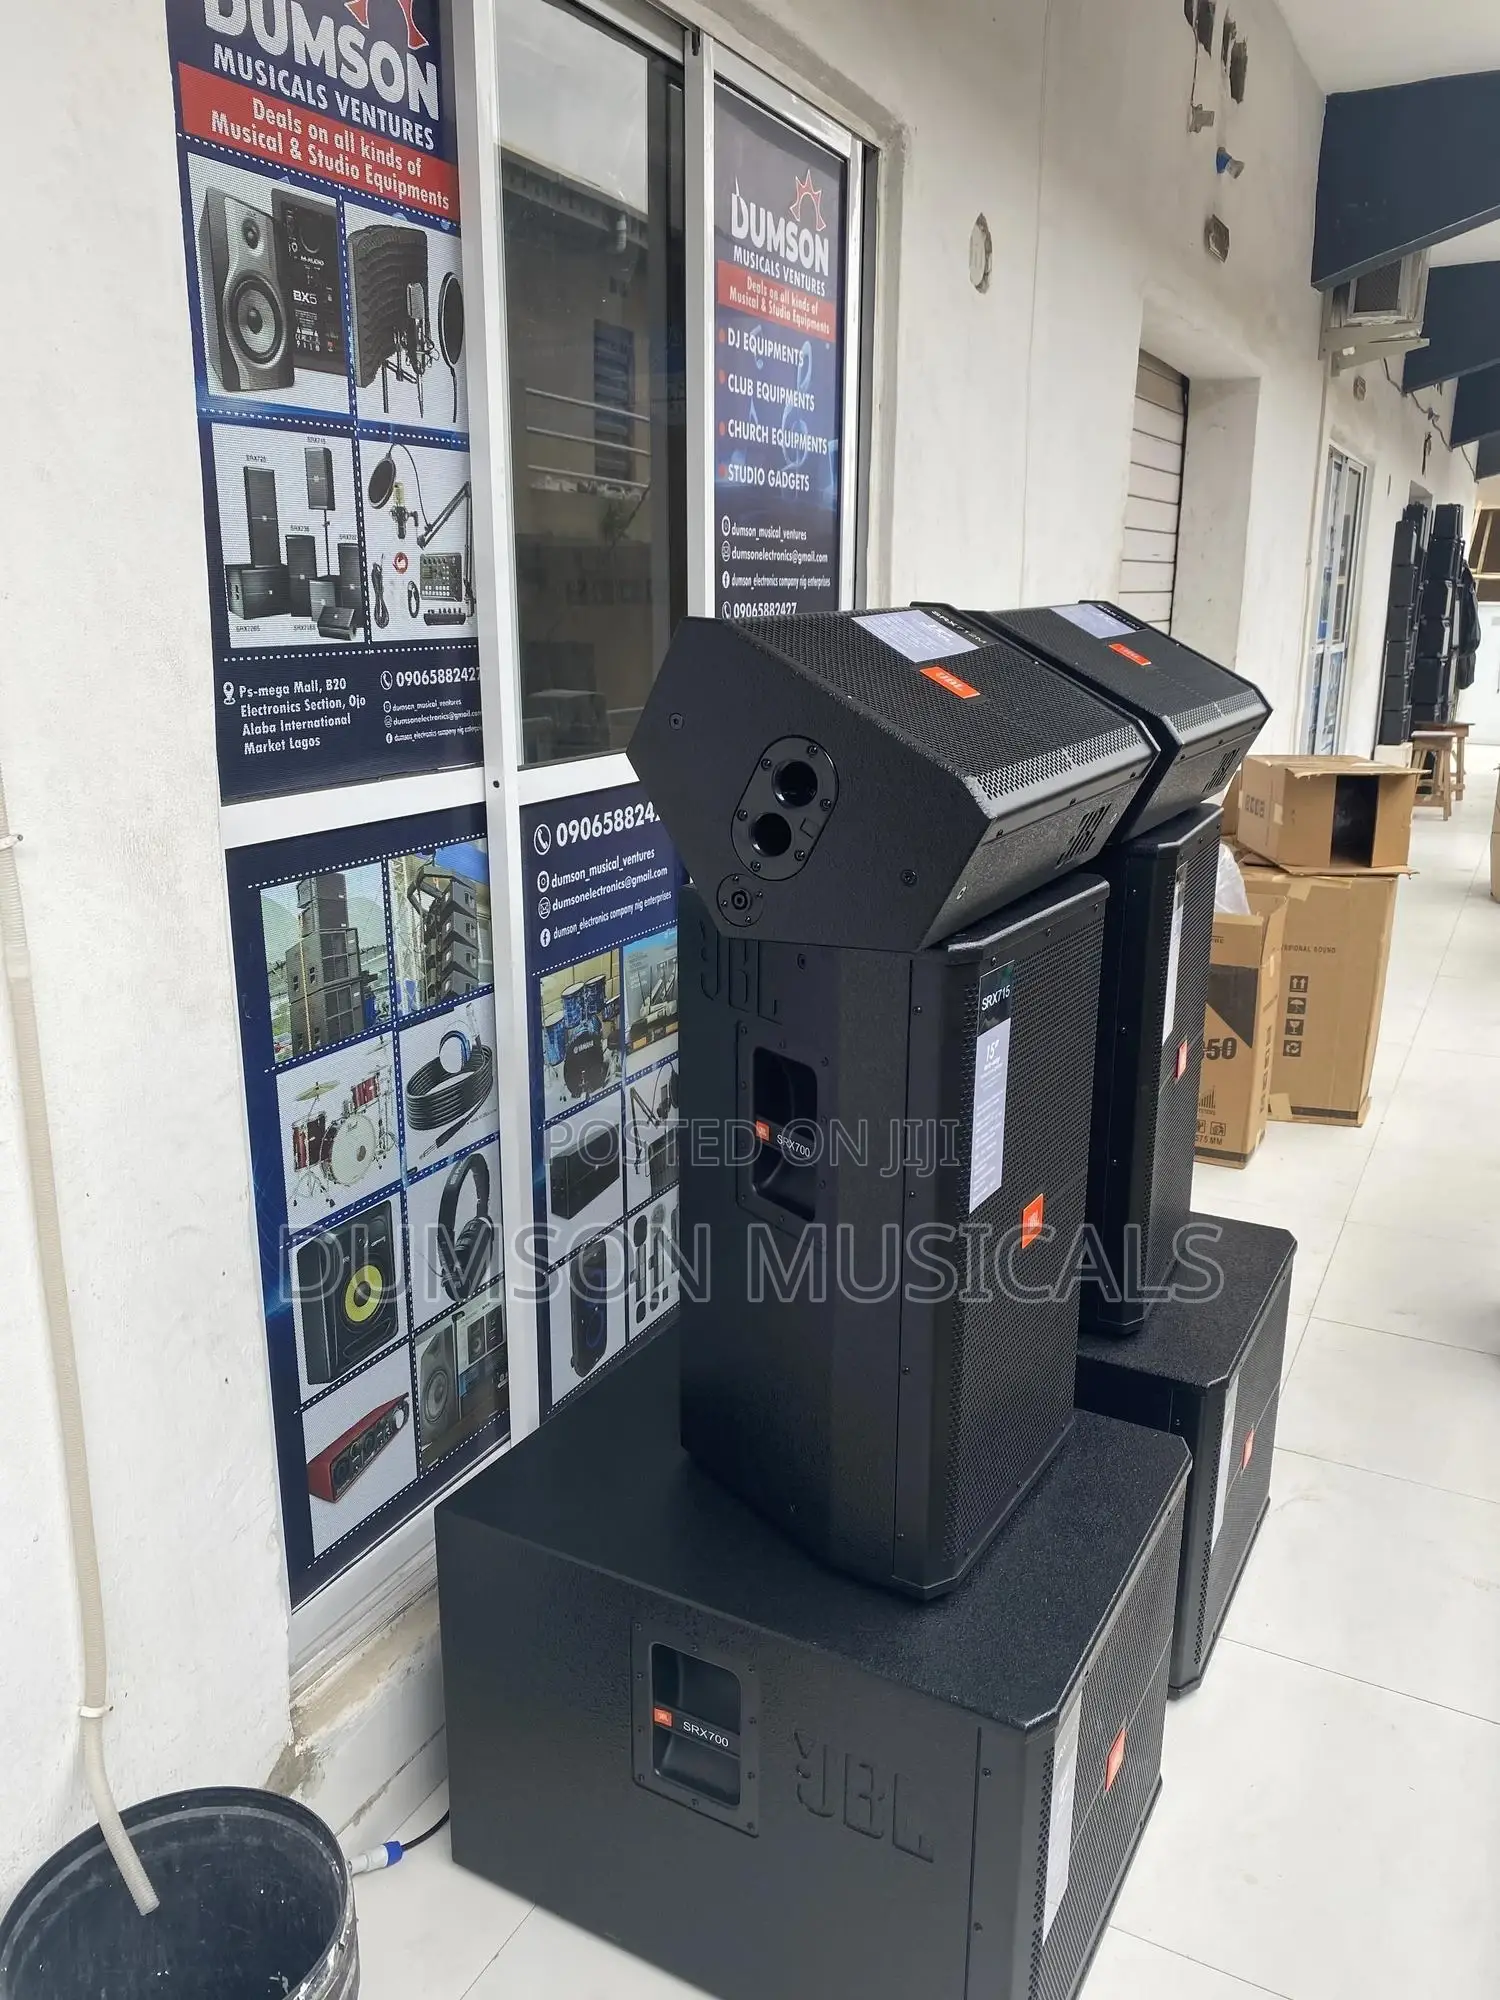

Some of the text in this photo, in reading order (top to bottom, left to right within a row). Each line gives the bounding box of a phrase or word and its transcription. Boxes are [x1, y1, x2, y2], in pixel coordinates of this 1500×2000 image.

[205, 0, 440, 121] DUMSON
[213, 43, 436, 151] MUSICALS VENTURES
[252, 97, 422, 178] Deals on all kinds of
[211, 109, 450, 211] Musical & Studio Equipments
[731, 188, 829, 276] DUMSON
[733, 245, 826, 297] MUSICALS VENTURES
[292, 289, 318, 305] BX5
[729, 287, 830, 335] Musical & Studio Equipments
[747, 276, 819, 315] Deals on all kinds of
[728, 328, 804, 368] DJ EQUIPMENTS
[728, 373, 815, 412] CLUB EQUIPMENTS
[728, 419, 828, 455] CHURCH EQUIPMENTS
[728, 464, 810, 492] STUDIO GADGETS
[731, 522, 807, 542] dumson_musical_ventures
[731, 548, 828, 564] dumsonelectronics@gmail.com
[731, 573, 778, 591] dumson_electronics
[779, 576, 799, 590] company
[808, 576, 831, 588] enterprises
[733, 602, 797, 619] 09065882427
[238, 678, 347, 699] Ps-mega Mall, B20
[240, 694, 367, 718] Electronics Section, Ojo
[242, 712, 351, 737] Alaba International
[244, 736, 321, 756] Market Lagos
[556, 800, 661, 847] 090658824
[551, 848, 655, 889] dumson_musical_ventures
[552, 866, 668, 911] dumsonelectronics@gmail.com
[553, 890, 672, 939] dumson_electronics company nig enterprises
[981, 984, 1011, 1011] SRX715
[1202, 1037, 1237, 1061] 50
[776, 1134, 811, 1158] SRX700
[682, 1721, 730, 1747] SRX700
